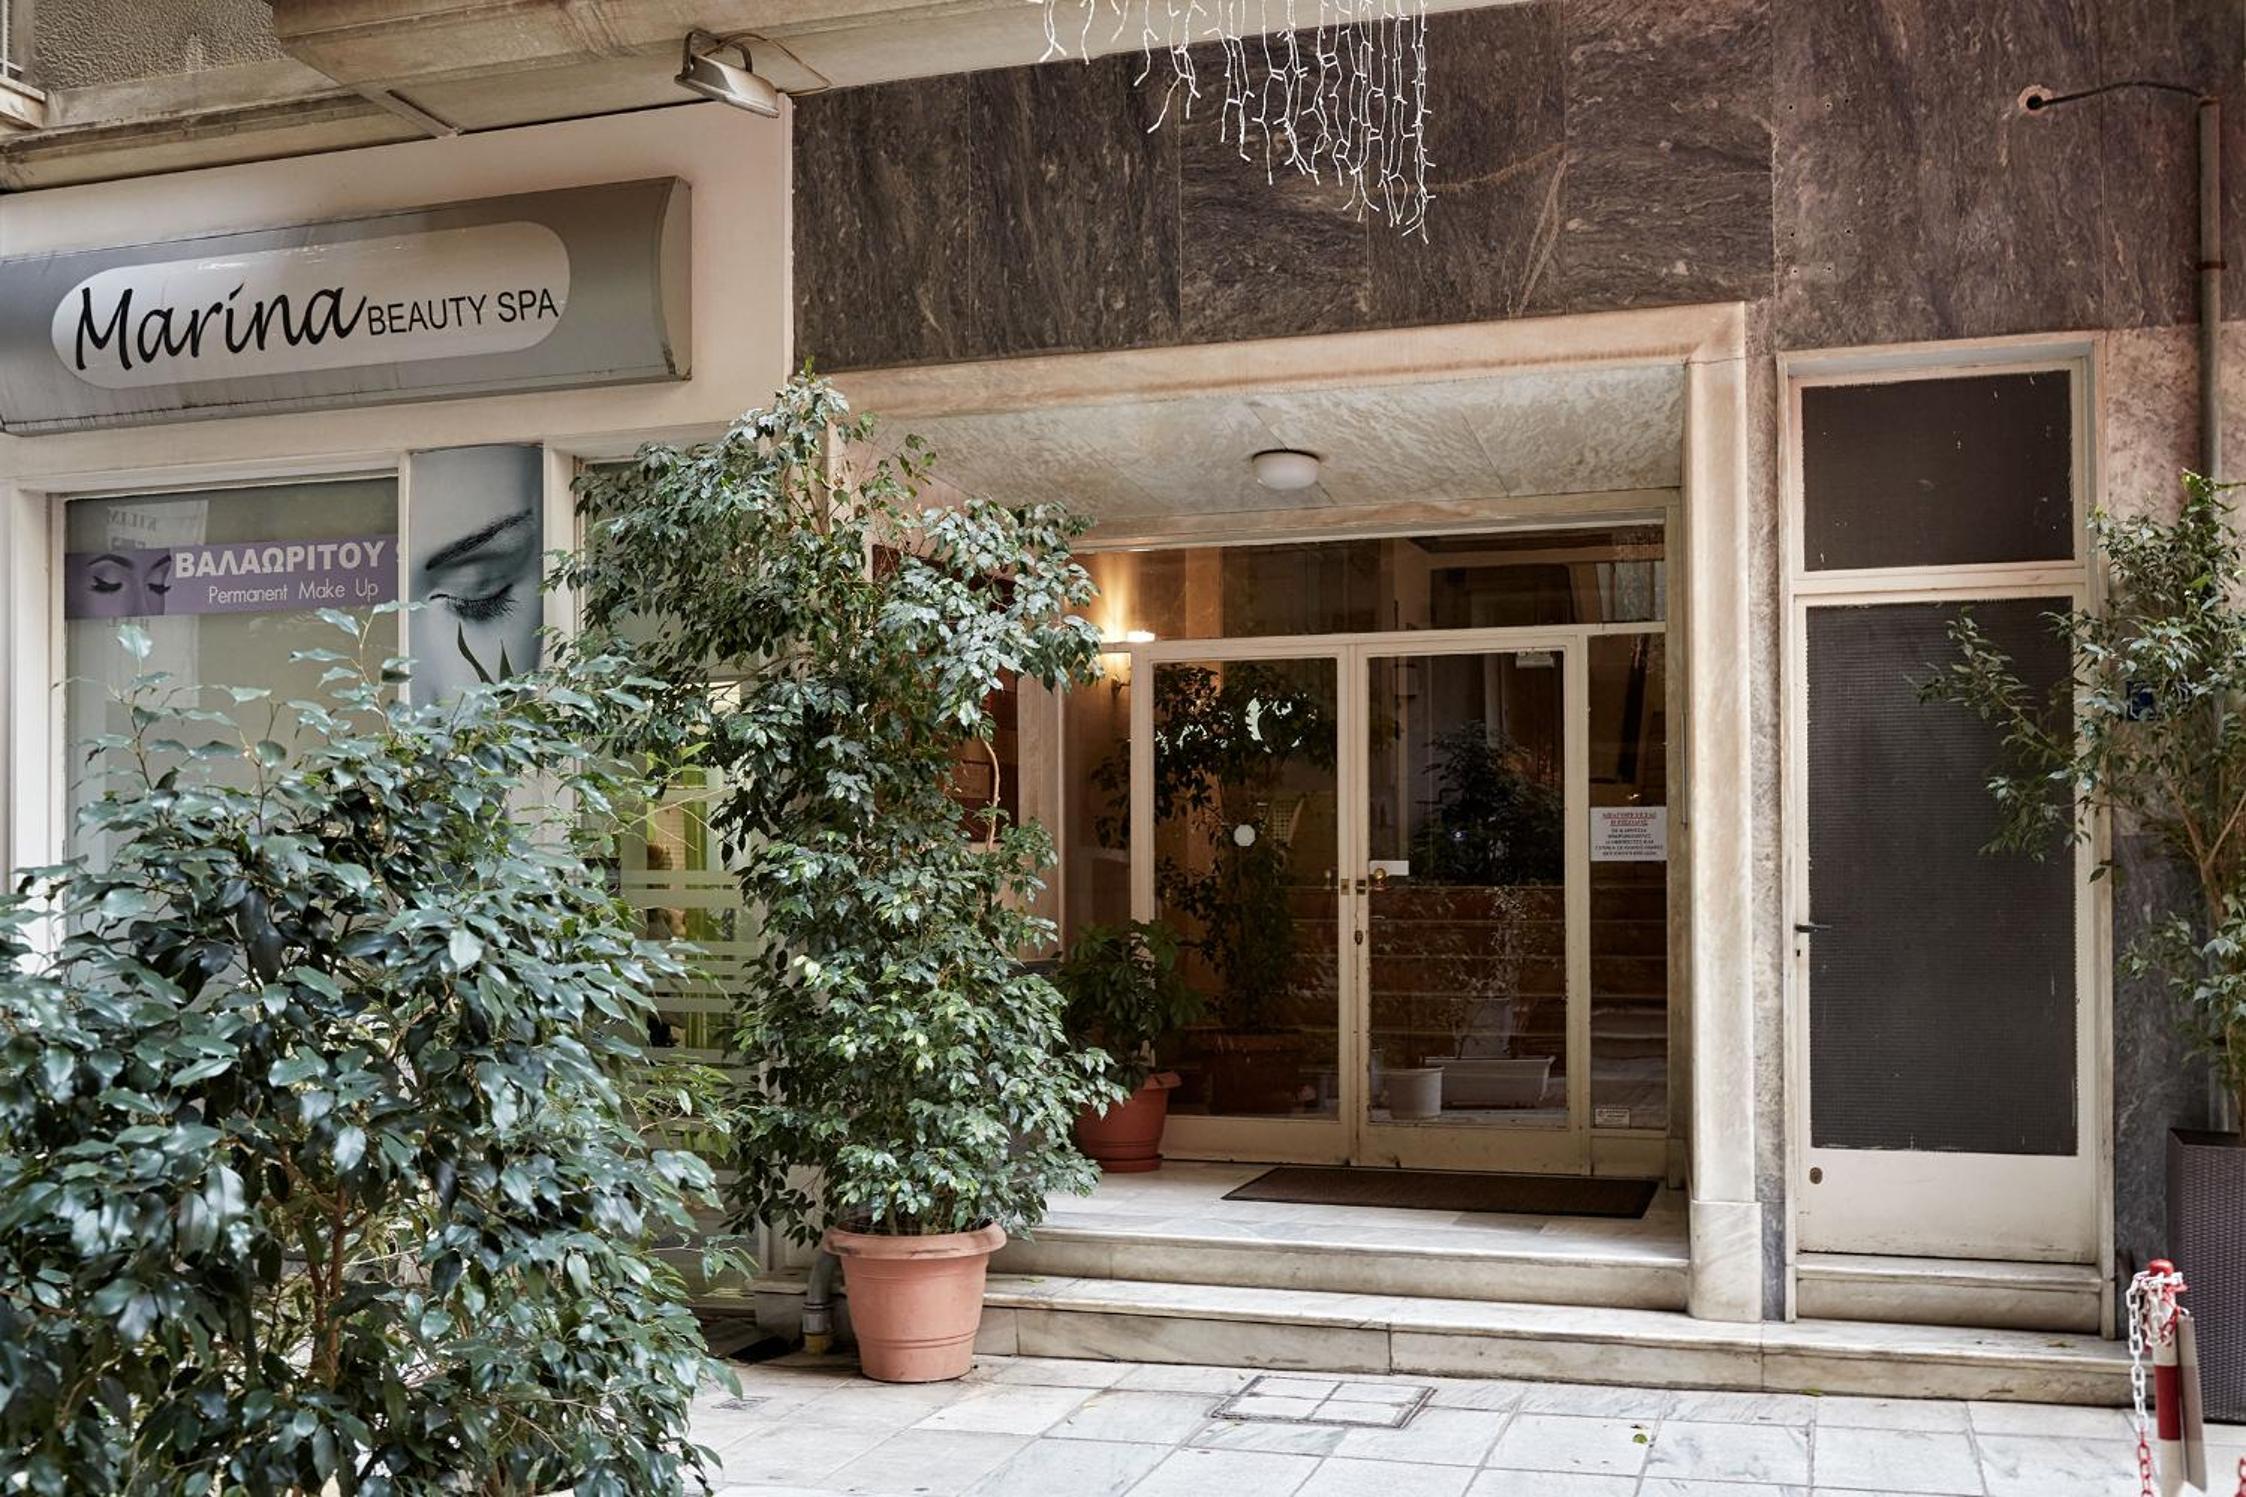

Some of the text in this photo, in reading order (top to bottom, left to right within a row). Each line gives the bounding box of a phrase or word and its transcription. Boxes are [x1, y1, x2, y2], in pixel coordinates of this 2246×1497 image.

[76, 282, 559, 371] Marina BEAUTY SPA
[175, 540, 386, 579] ΒΑΛΑΩΡΙΤΟΥ
[208, 577, 379, 604] Permanent Make Up
